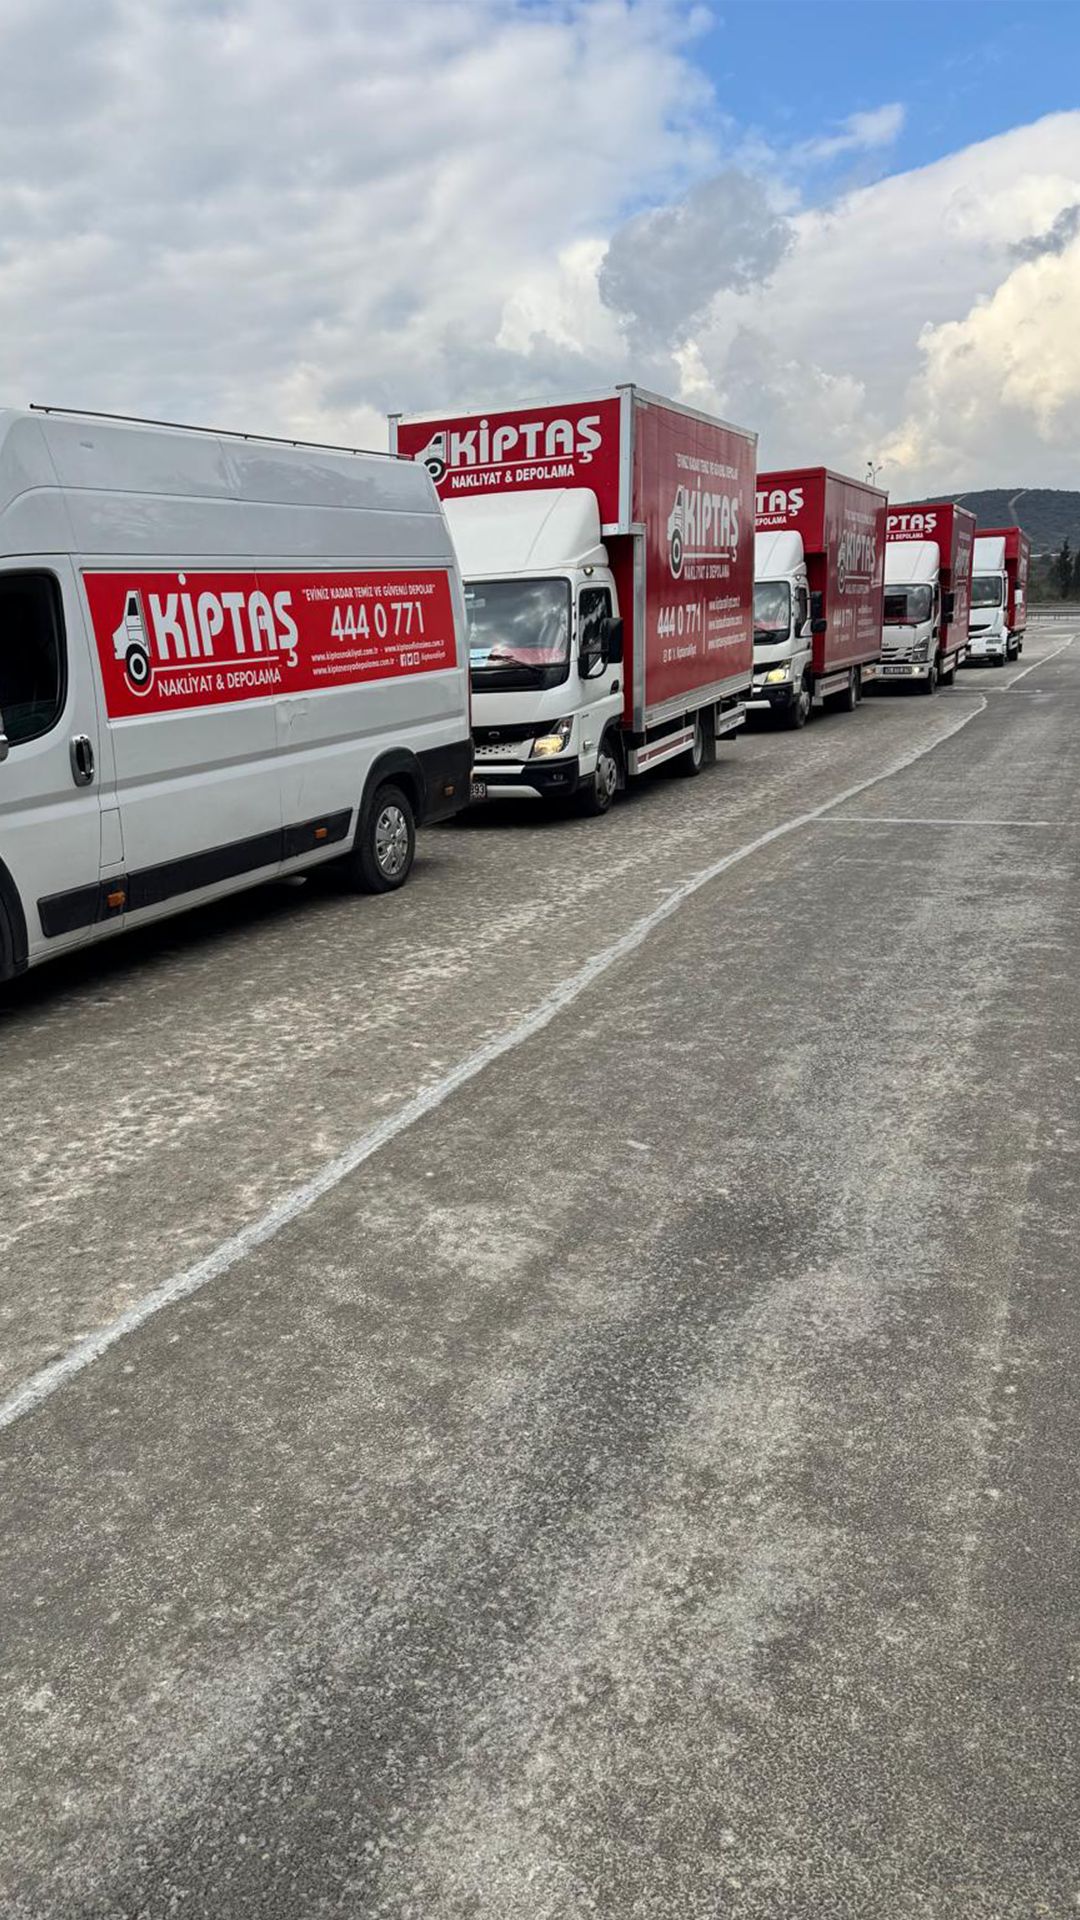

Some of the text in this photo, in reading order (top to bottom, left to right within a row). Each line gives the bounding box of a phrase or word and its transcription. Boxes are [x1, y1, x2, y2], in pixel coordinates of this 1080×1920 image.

[450, 415, 602, 467] KİPTAŞ
[452, 464, 575, 489] NAKLİYAT & DEPOLAMA
[755, 488, 804, 516] TAŞ
[684, 475, 739, 562] KİPTAŞ
[755, 516, 787, 526] EPOLAMA
[886, 513, 937, 533] PTAŞ
[331, 587, 354, 600] KADAR
[374, 585, 382, 597] VE
[149, 573, 299, 667] KİPTAŞ
[331, 601, 424, 642] 444 0 771
[657, 606, 675, 639] 444
[677, 605, 684, 637] 0
[686, 602, 701, 634] 771
[157, 668, 282, 697] NAKLİYAT & DEPOLAMA
